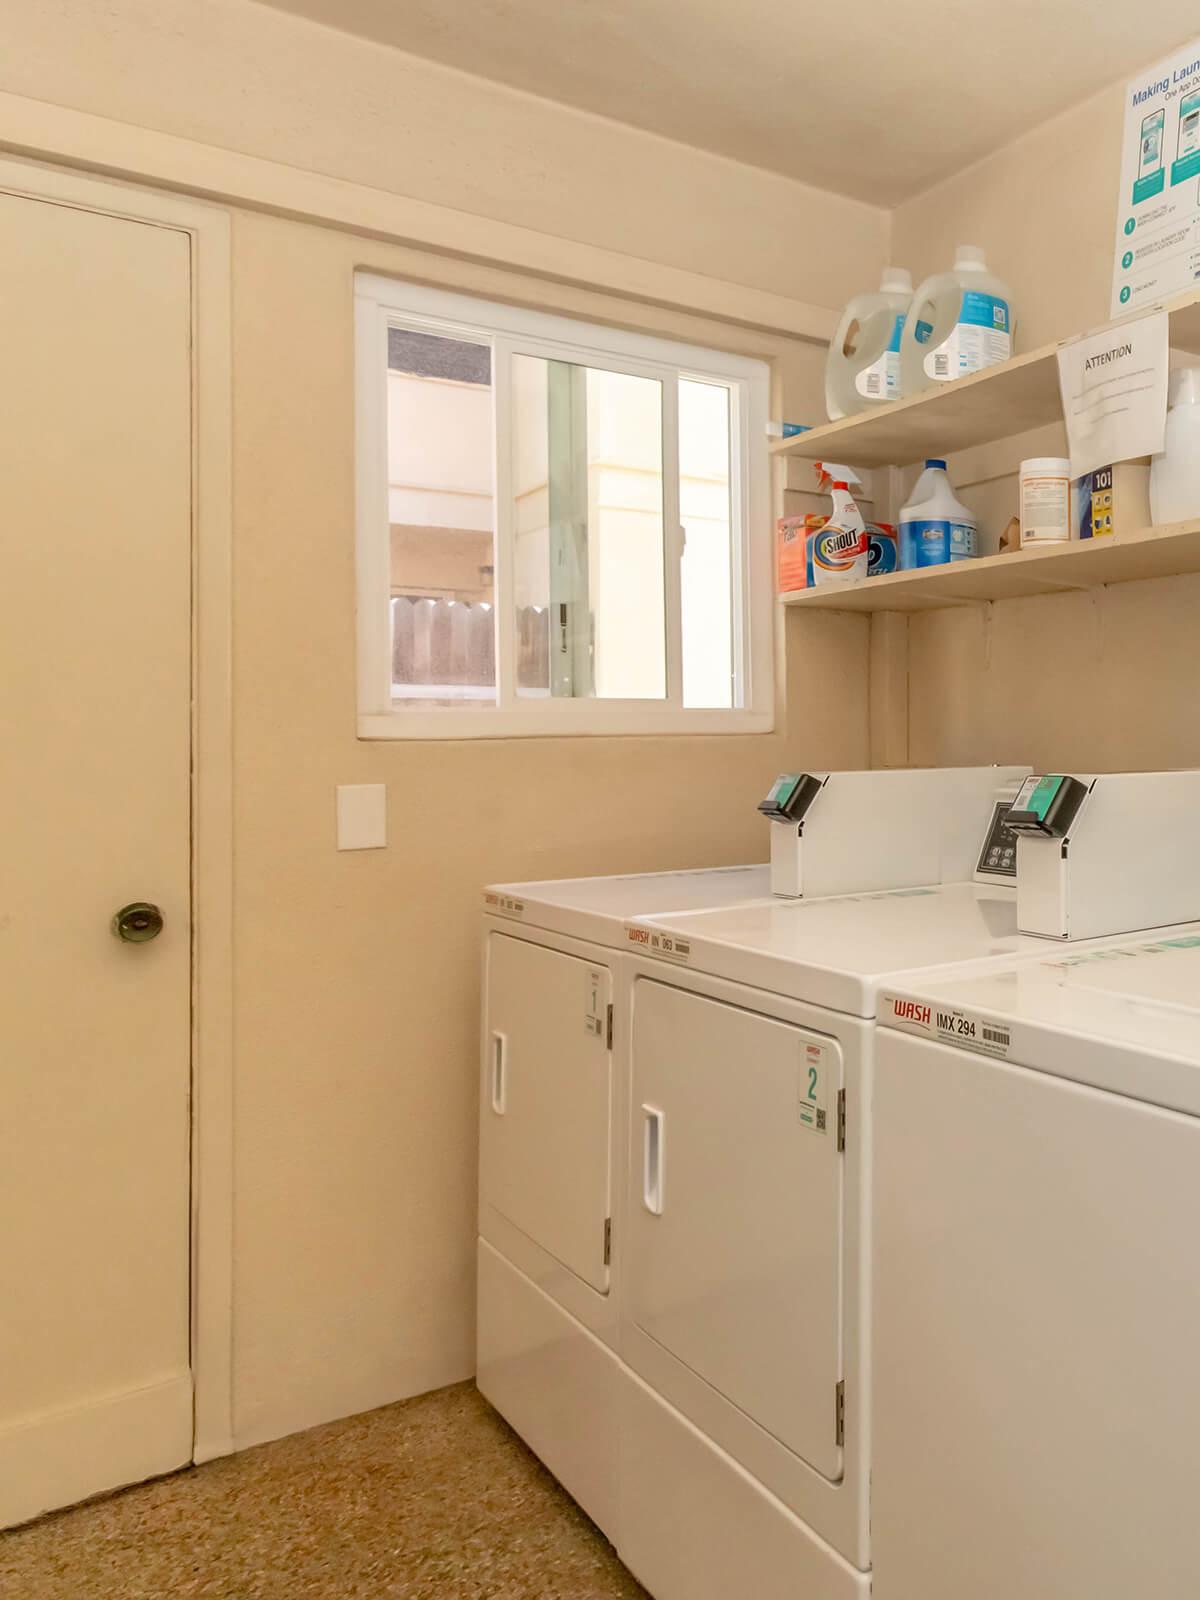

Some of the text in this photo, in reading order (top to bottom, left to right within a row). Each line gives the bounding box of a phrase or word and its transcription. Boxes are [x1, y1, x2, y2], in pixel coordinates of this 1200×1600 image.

[1132, 78, 1170, 106] Making
[1164, 89, 1178, 101] One
[1180, 83, 1191, 93] App
[1085, 344, 1132, 371] ATTENTION
[1095, 471, 1111, 488] 101
[826, 528, 857, 554] SHOUT
[629, 928, 650, 944] WASH
[894, 999, 931, 1024] WASH
[936, 1013, 976, 1037] IMX 294
[808, 1067, 817, 1100] 2
